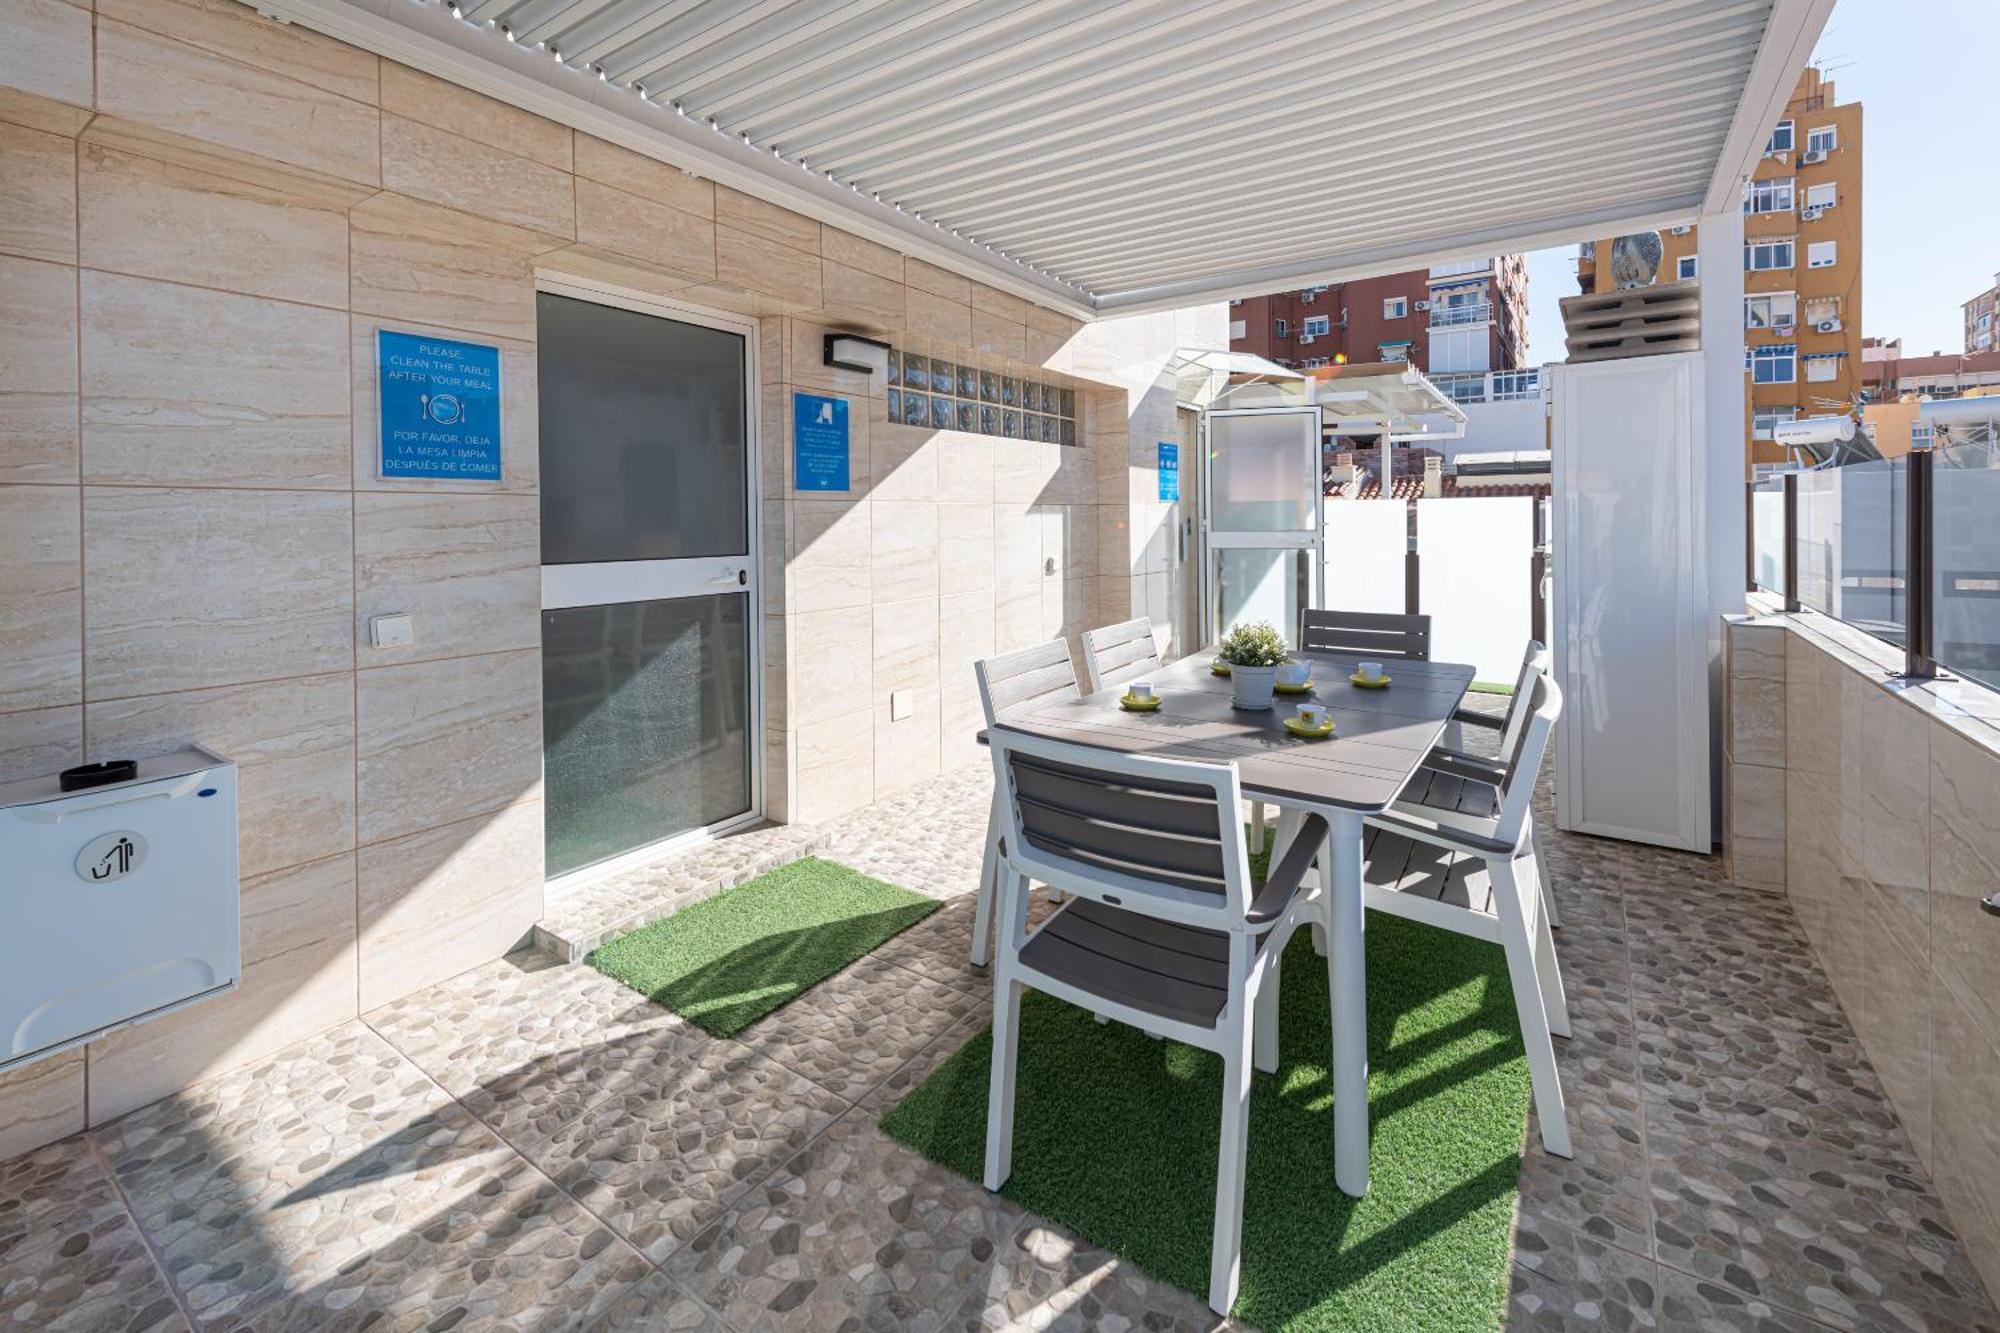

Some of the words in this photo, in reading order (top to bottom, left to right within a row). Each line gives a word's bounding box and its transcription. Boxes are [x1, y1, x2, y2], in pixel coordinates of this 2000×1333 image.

[390, 355, 429, 368] CLEAN
[432, 360, 454, 371] THE
[459, 364, 491, 377] TABLE
[388, 371, 426, 382] AFTER
[431, 375, 461, 386] YOUR
[464, 379, 492, 390] MEAL
[393, 431, 418, 441] POR
[465, 435, 490, 445] DEJA
[398, 445, 414, 455] LA
[417, 447, 448, 457] MESA
[453, 449, 487, 459] LIMPIA
[385, 459, 439, 470] DESPUÉS
[442, 462, 457, 471] DE
[460, 462, 498, 473] COMER
